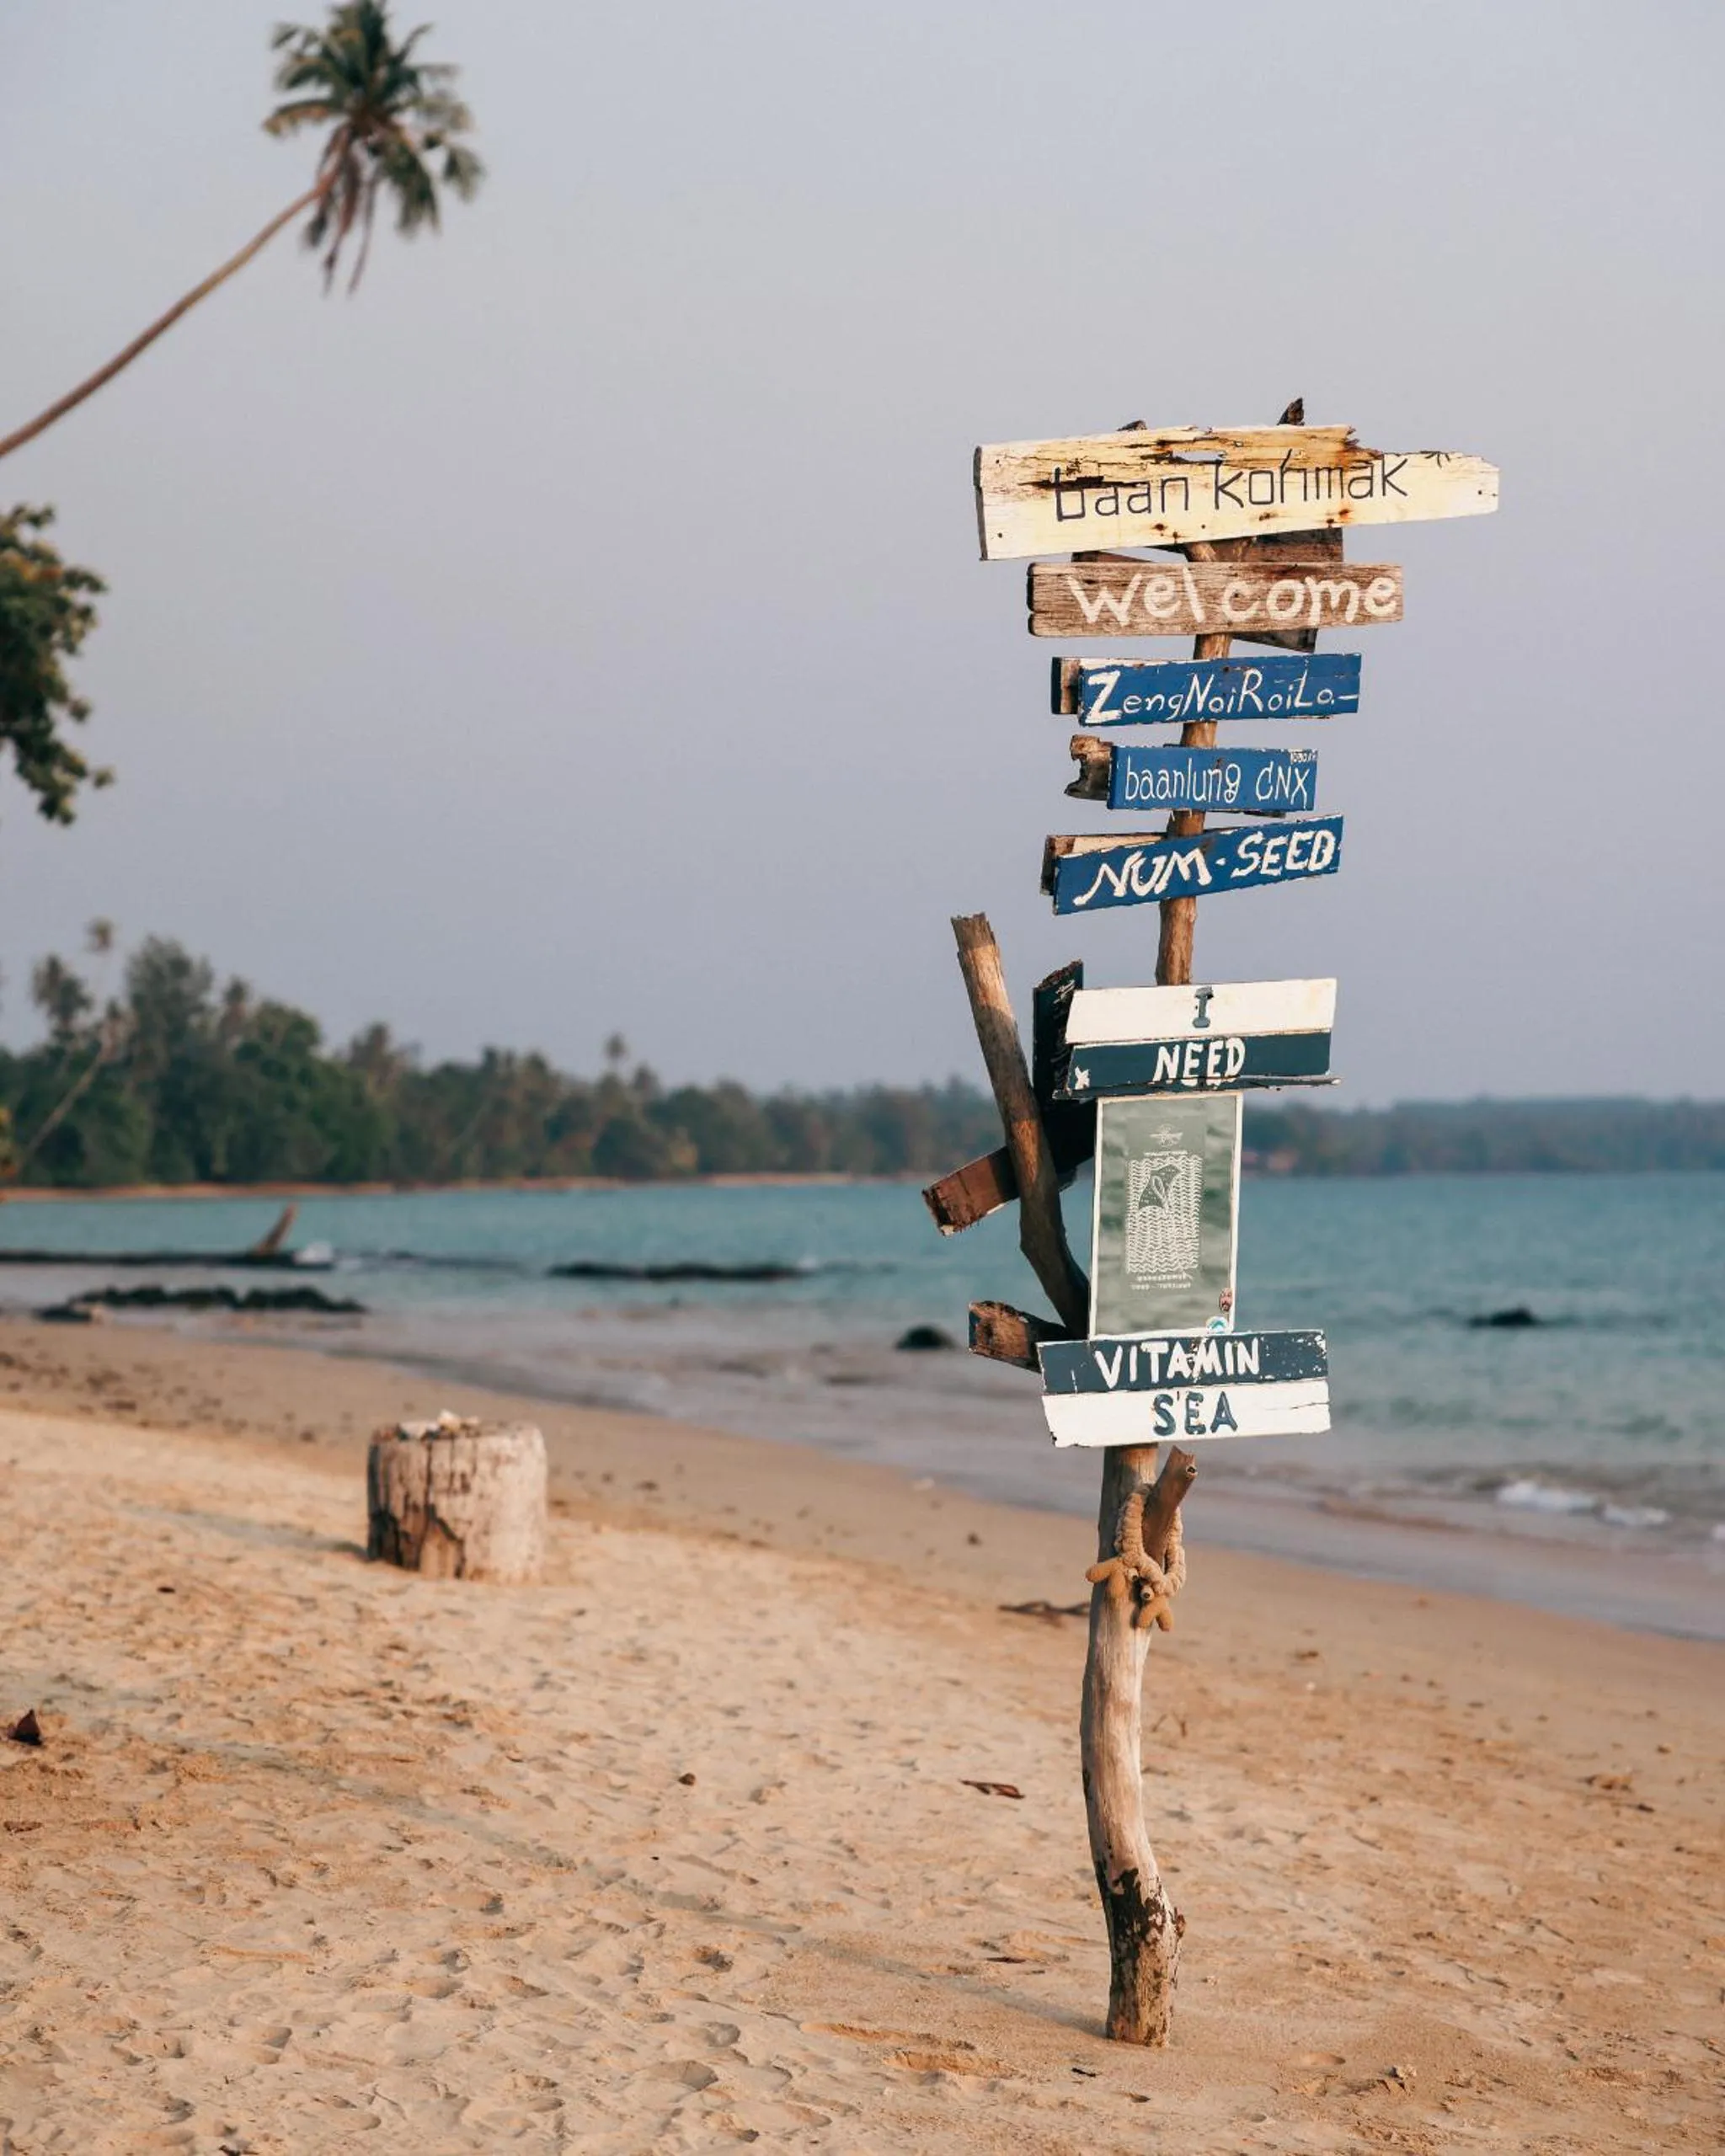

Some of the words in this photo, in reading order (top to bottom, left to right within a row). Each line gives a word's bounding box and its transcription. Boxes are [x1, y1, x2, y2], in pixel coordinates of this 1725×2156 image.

[1066, 567, 1399, 627] welcome
[1124, 755, 1242, 804] baanlung
[1192, 985, 1215, 1029] I
[1150, 1036, 1247, 1090] NEED
[1095, 1337, 1260, 1390] VITAMIN
[1152, 1390, 1239, 1437] SEA
